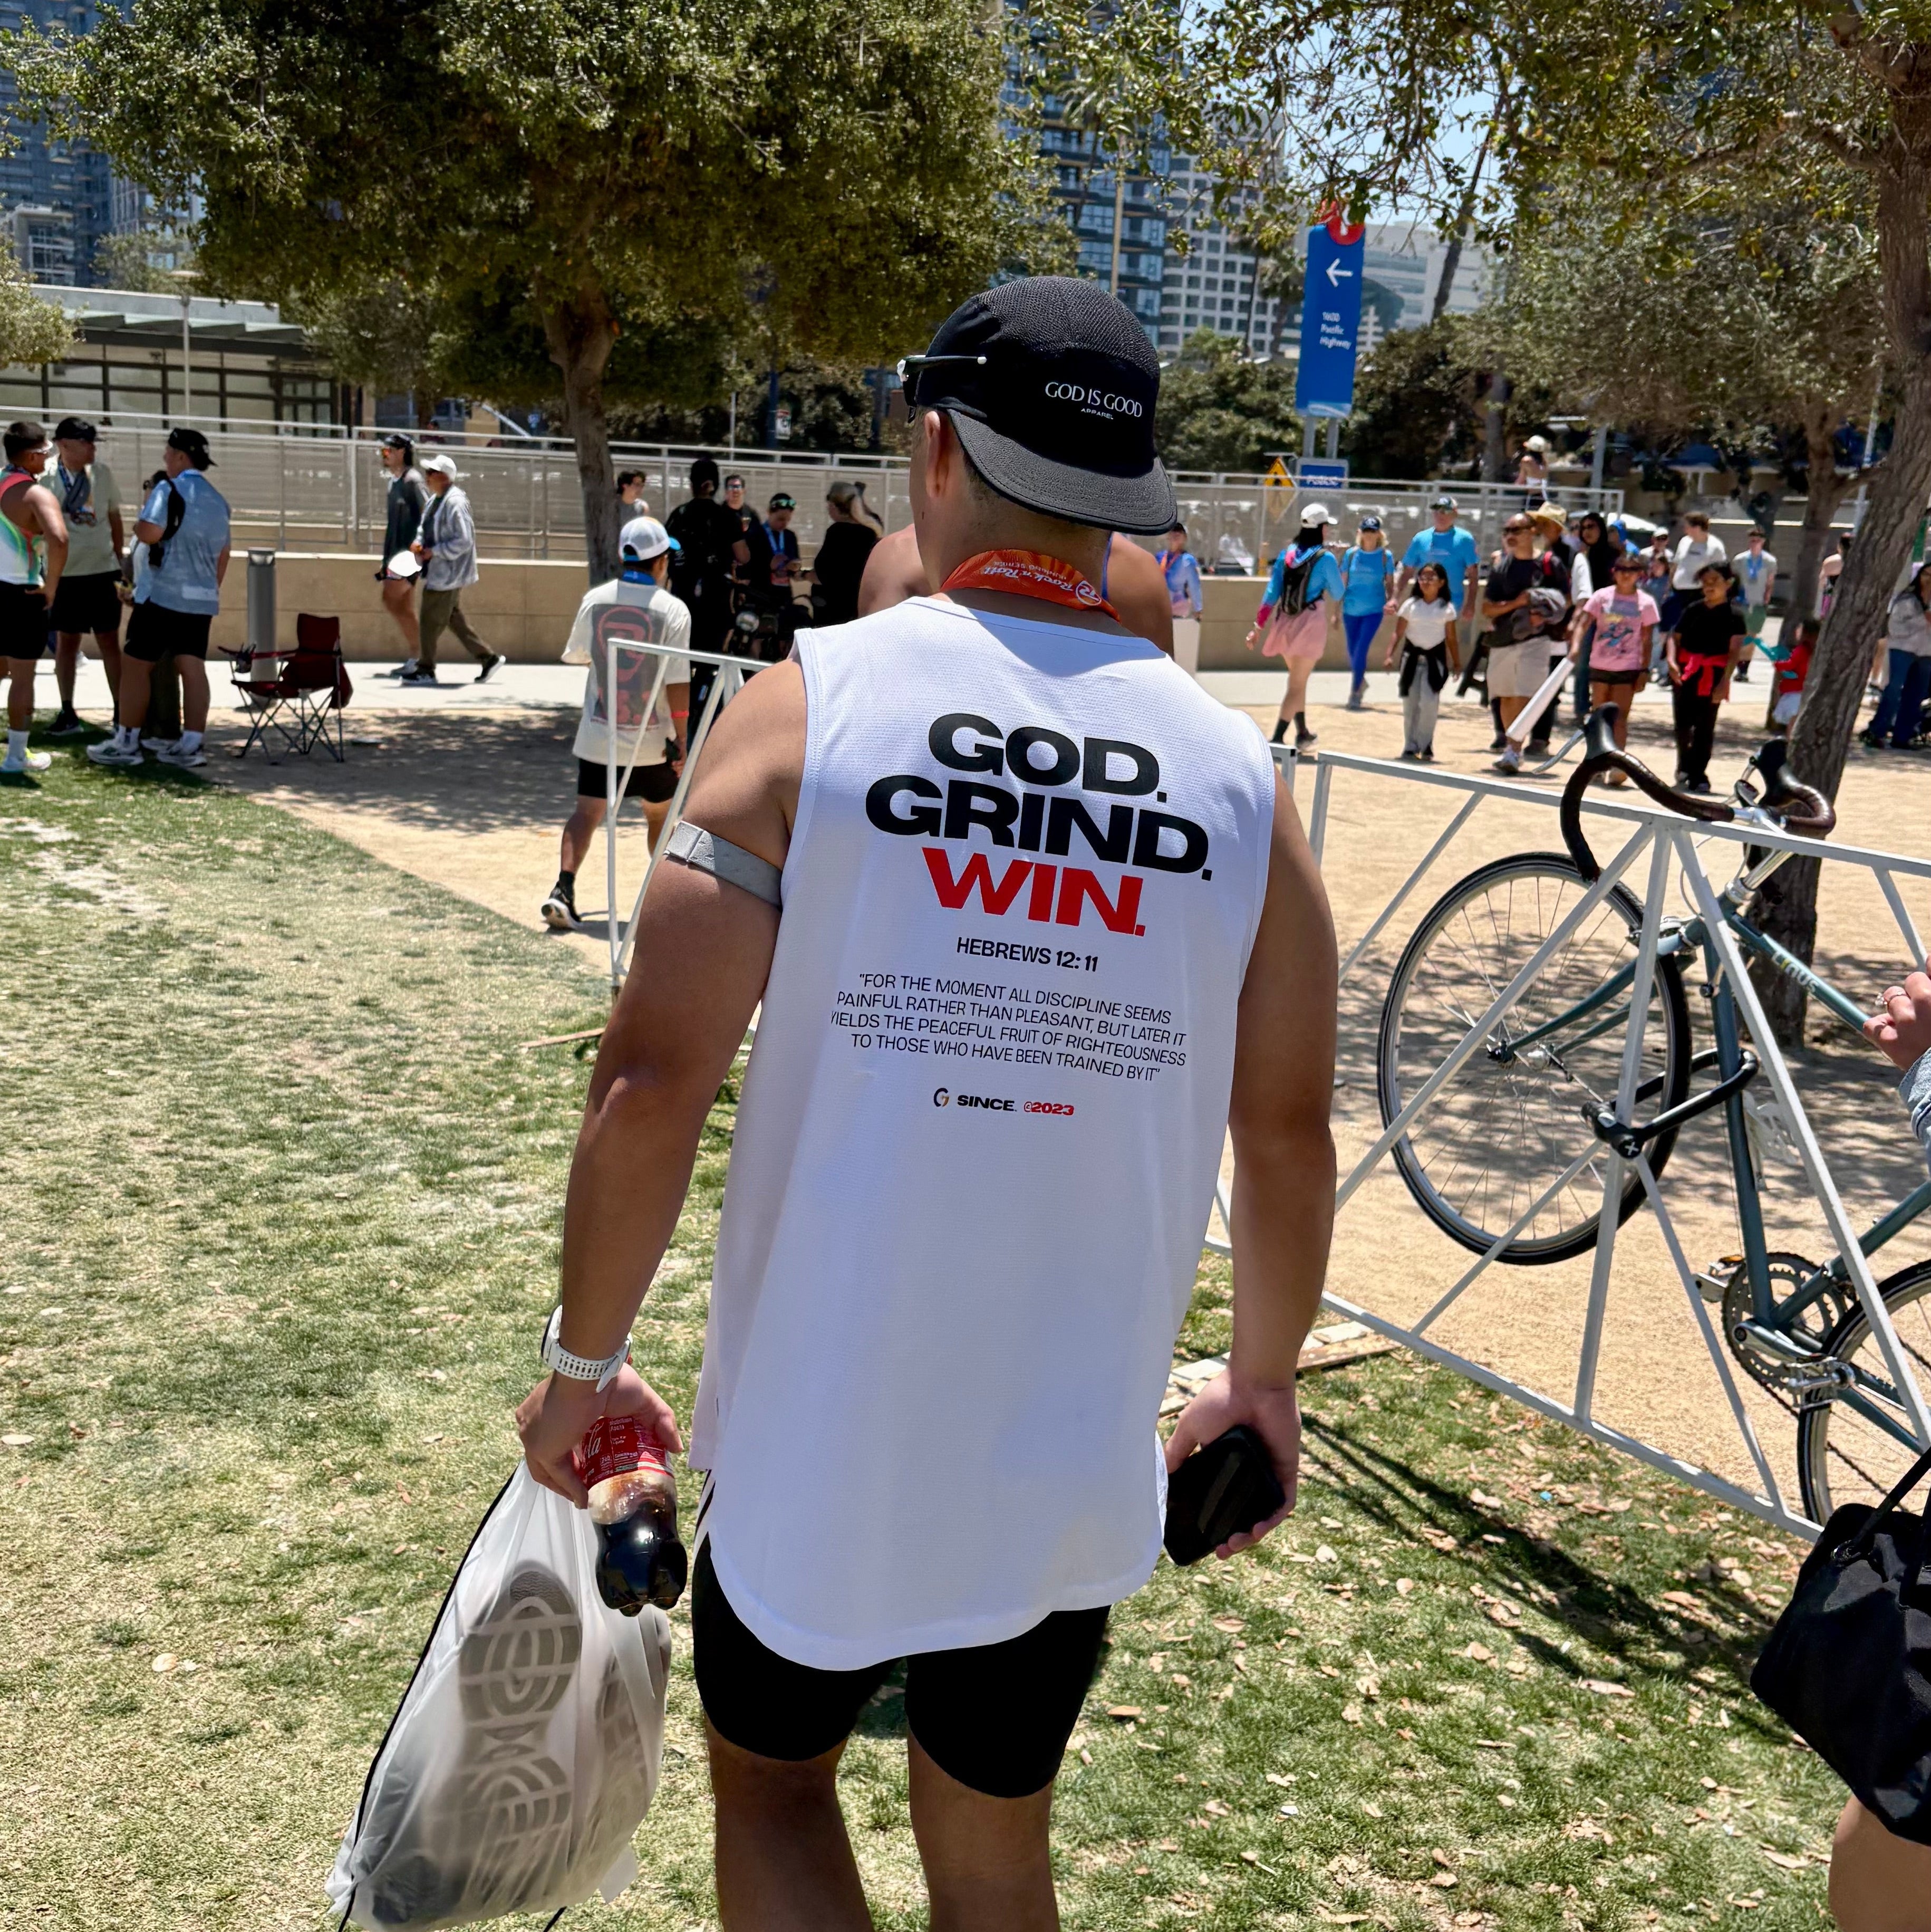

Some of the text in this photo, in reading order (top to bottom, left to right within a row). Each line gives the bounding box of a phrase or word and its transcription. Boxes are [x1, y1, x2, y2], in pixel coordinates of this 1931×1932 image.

[1319, 336, 1351, 350] Highway
[1045, 382, 1142, 417] GOD IS GOOD
[1080, 408, 1114, 420] APPAREL
[983, 566, 1019, 579] Roll
[1034, 572, 1074, 591] Rock
[929, 714, 1167, 803] GOD.
[866, 775, 1212, 881] GRIND.
[922, 848, 1146, 937] WIN.
[957, 936, 1051, 965] HEBREWS
[837, 991, 1186, 1046] PAINFUL RATHER THAN PLEASANT, BUT LATER IT
[901, 975, 932, 992] THE
[936, 978, 1007, 999] MOMENT
[1009, 987, 1031, 1003] ALL
[1035, 990, 1122, 1017] DISCIPLINE
[1124, 1004, 1171, 1024] SEEMS
[831, 1011, 1186, 1065] YIELDS THE PEACEFUL FRUIT OF RIGHTEOUSNESS
[851, 1034, 871, 1047] TO
[876, 1034, 930, 1053] THOSE
[934, 1040, 968, 1056] WHO
[972, 1044, 1013, 1062] HAVE
[1016, 1049, 1053, 1065] BEEN
[1056, 1053, 1124, 1076] TRAINED
